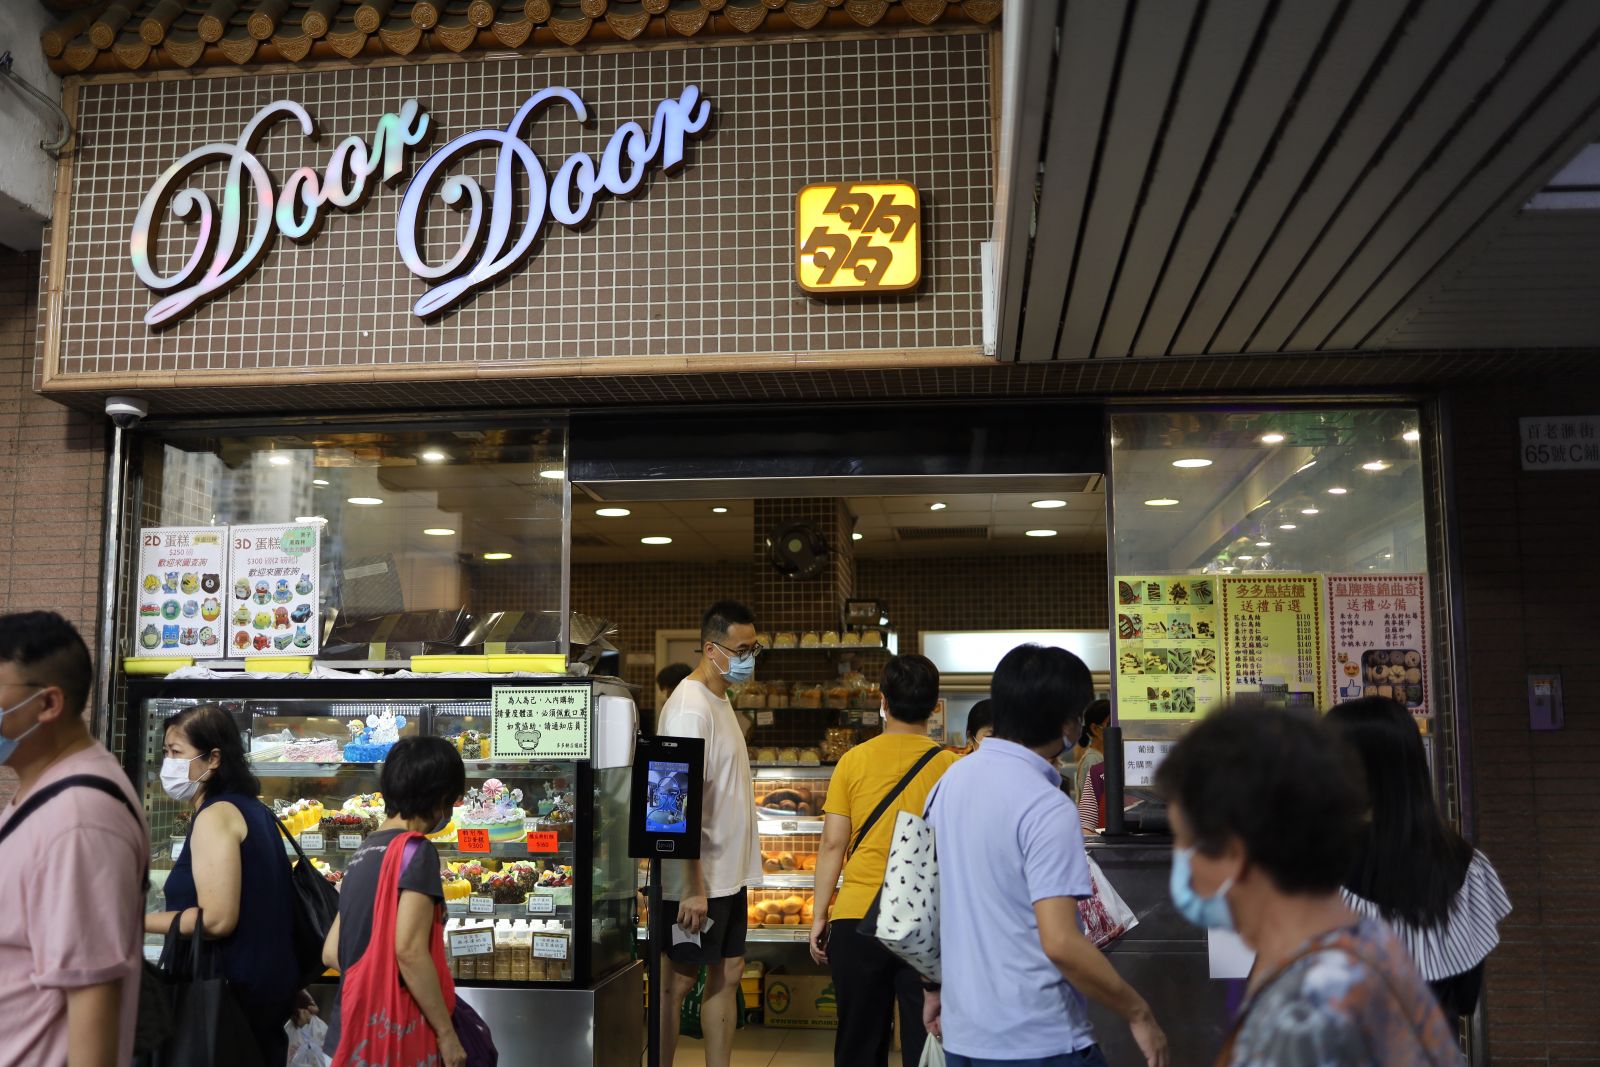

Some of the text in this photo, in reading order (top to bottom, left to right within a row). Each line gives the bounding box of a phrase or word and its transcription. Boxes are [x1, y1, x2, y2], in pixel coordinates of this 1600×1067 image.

[130, 84, 711, 327] Door Door
[144, 535, 161, 547] 2D
[164, 535, 190, 547] 蛋糕
[234, 537, 281, 551] 3D 蛋糕
[1236, 584, 1305, 598] 多多鳥結糖
[1335, 583, 1418, 596] 皇牌雜錦曲奇
[1241, 599, 1302, 613] 送禮首選
[1347, 599, 1407, 611] 送禮必備
